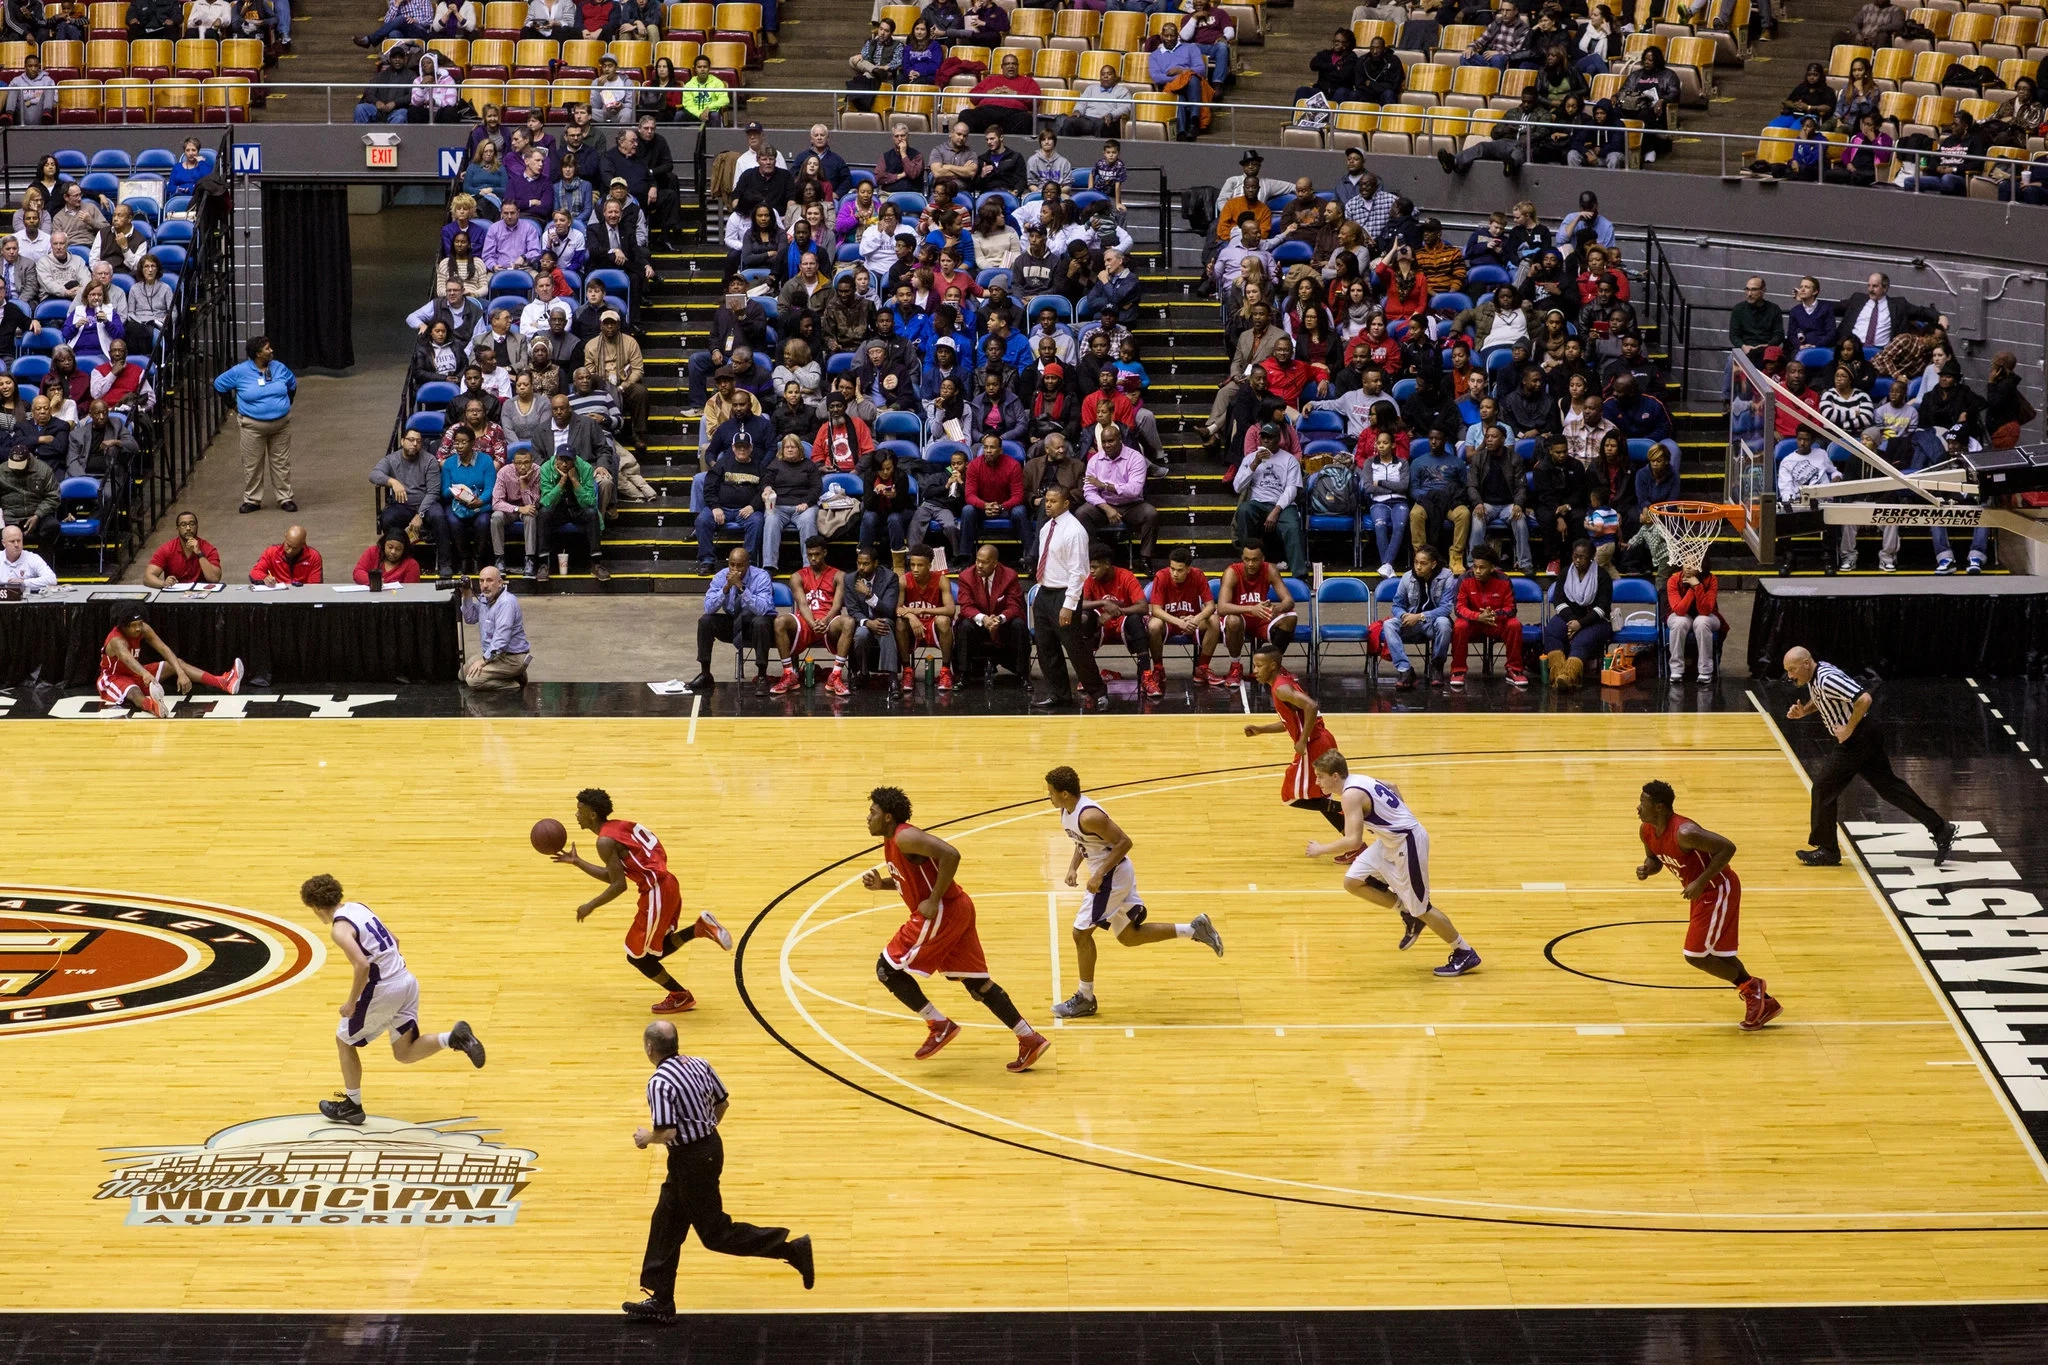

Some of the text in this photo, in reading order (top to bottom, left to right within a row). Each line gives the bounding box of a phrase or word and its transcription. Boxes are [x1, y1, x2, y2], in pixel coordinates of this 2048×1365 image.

[233, 147, 260, 170] M
[371, 148, 393, 164] EXIT
[441, 151, 464, 176] N
[1870, 516, 1980, 526] SPORTS SYSTEMS
[1872, 507, 1983, 519] PERFORMANCE
[1165, 601, 1195, 613] PEARL
[1374, 783, 1401, 809] 3
[365, 916, 394, 952] 14
[98, 1165, 285, 1200] Nashville
[144, 1213, 497, 1225] AUDITORIUM
